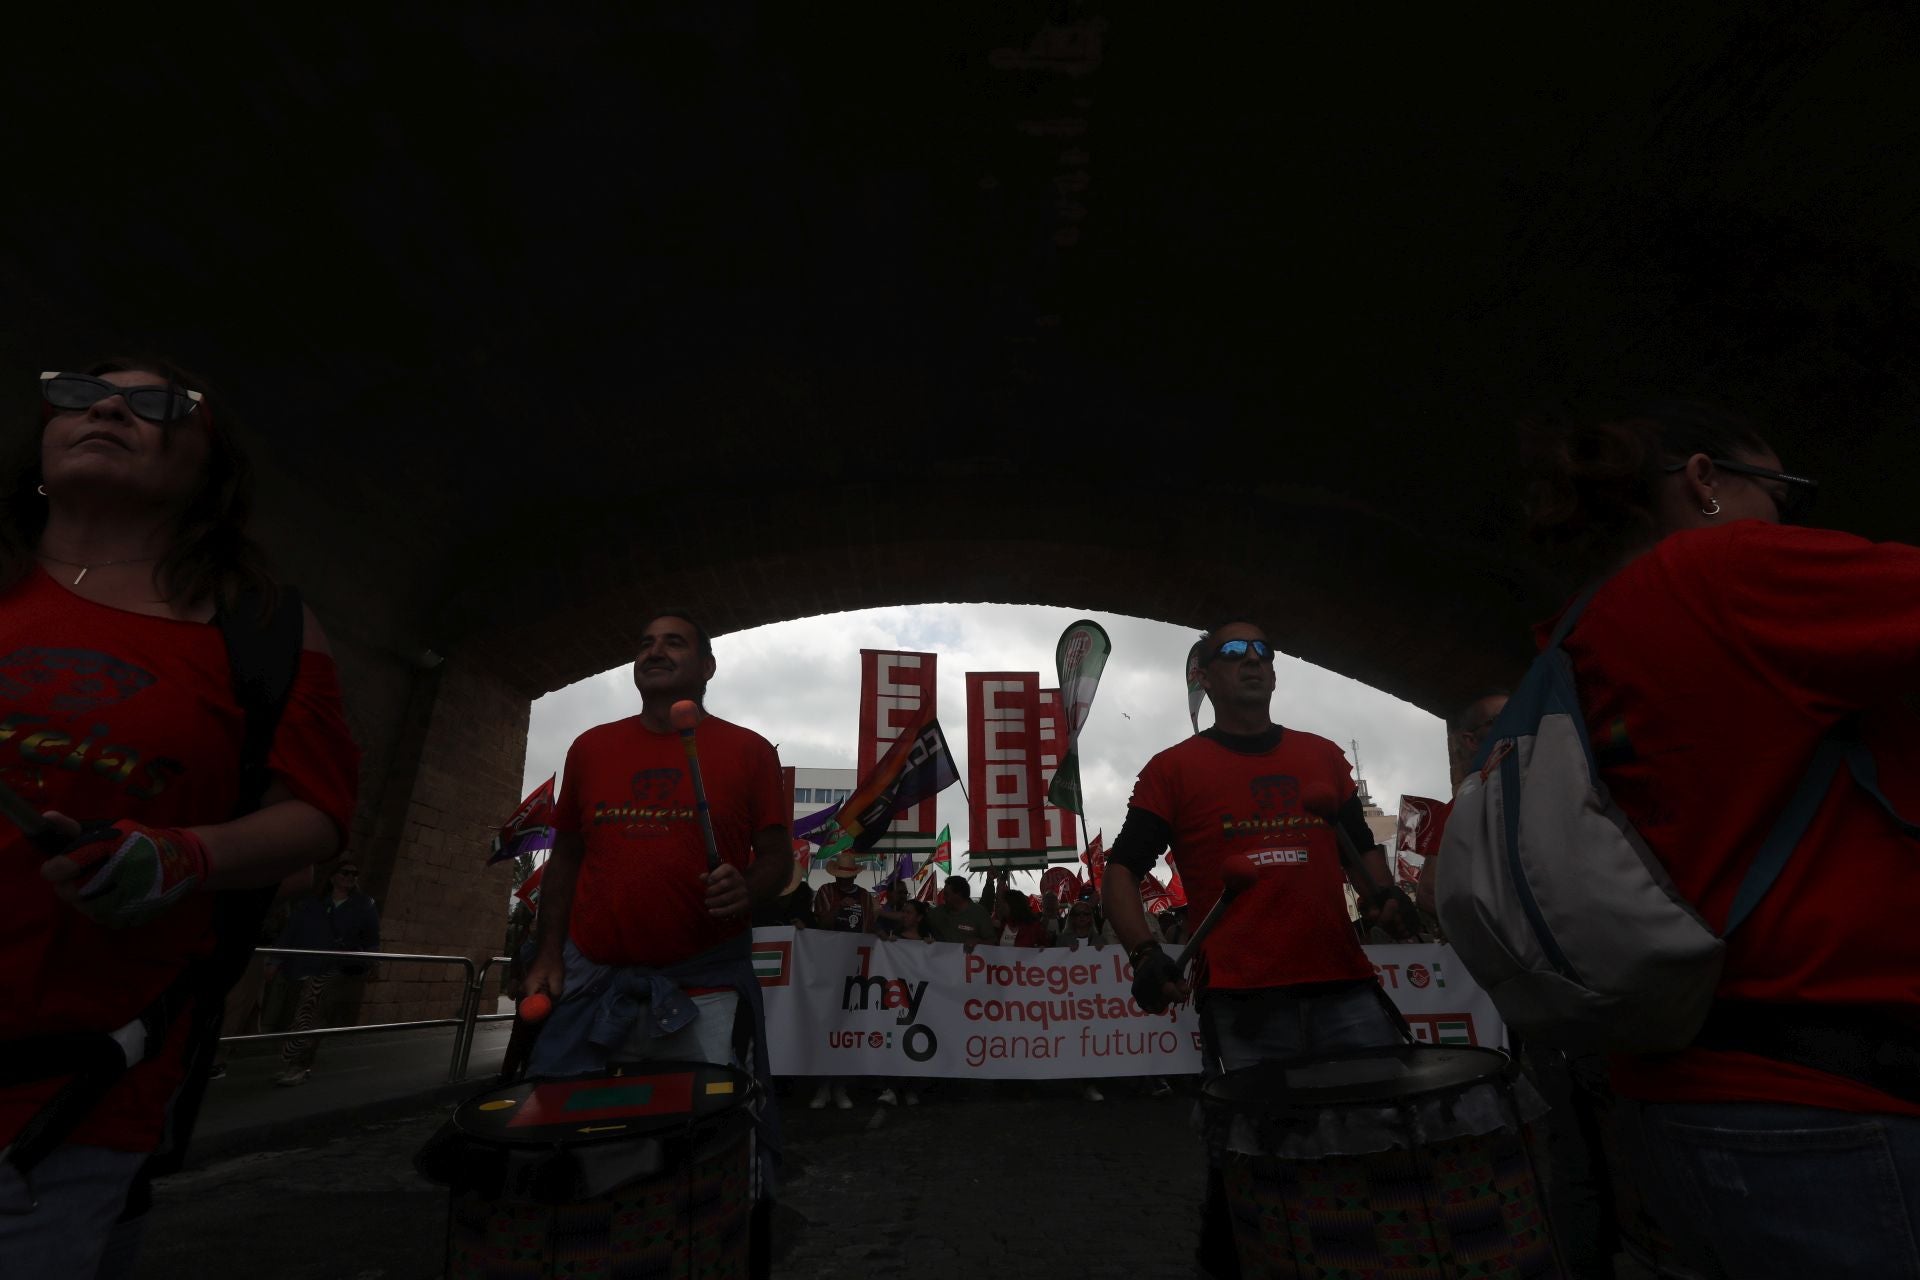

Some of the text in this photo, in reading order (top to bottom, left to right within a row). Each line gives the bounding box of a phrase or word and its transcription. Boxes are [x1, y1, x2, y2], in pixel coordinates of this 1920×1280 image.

[982, 680, 1032, 850] CCOO
[856, 946, 872, 979] 1
[964, 954, 1102, 995] Proteger
[828, 1031, 866, 1049] UGT
[965, 1033, 1066, 1068] ganar
[1079, 1025, 1178, 1057] futuro
